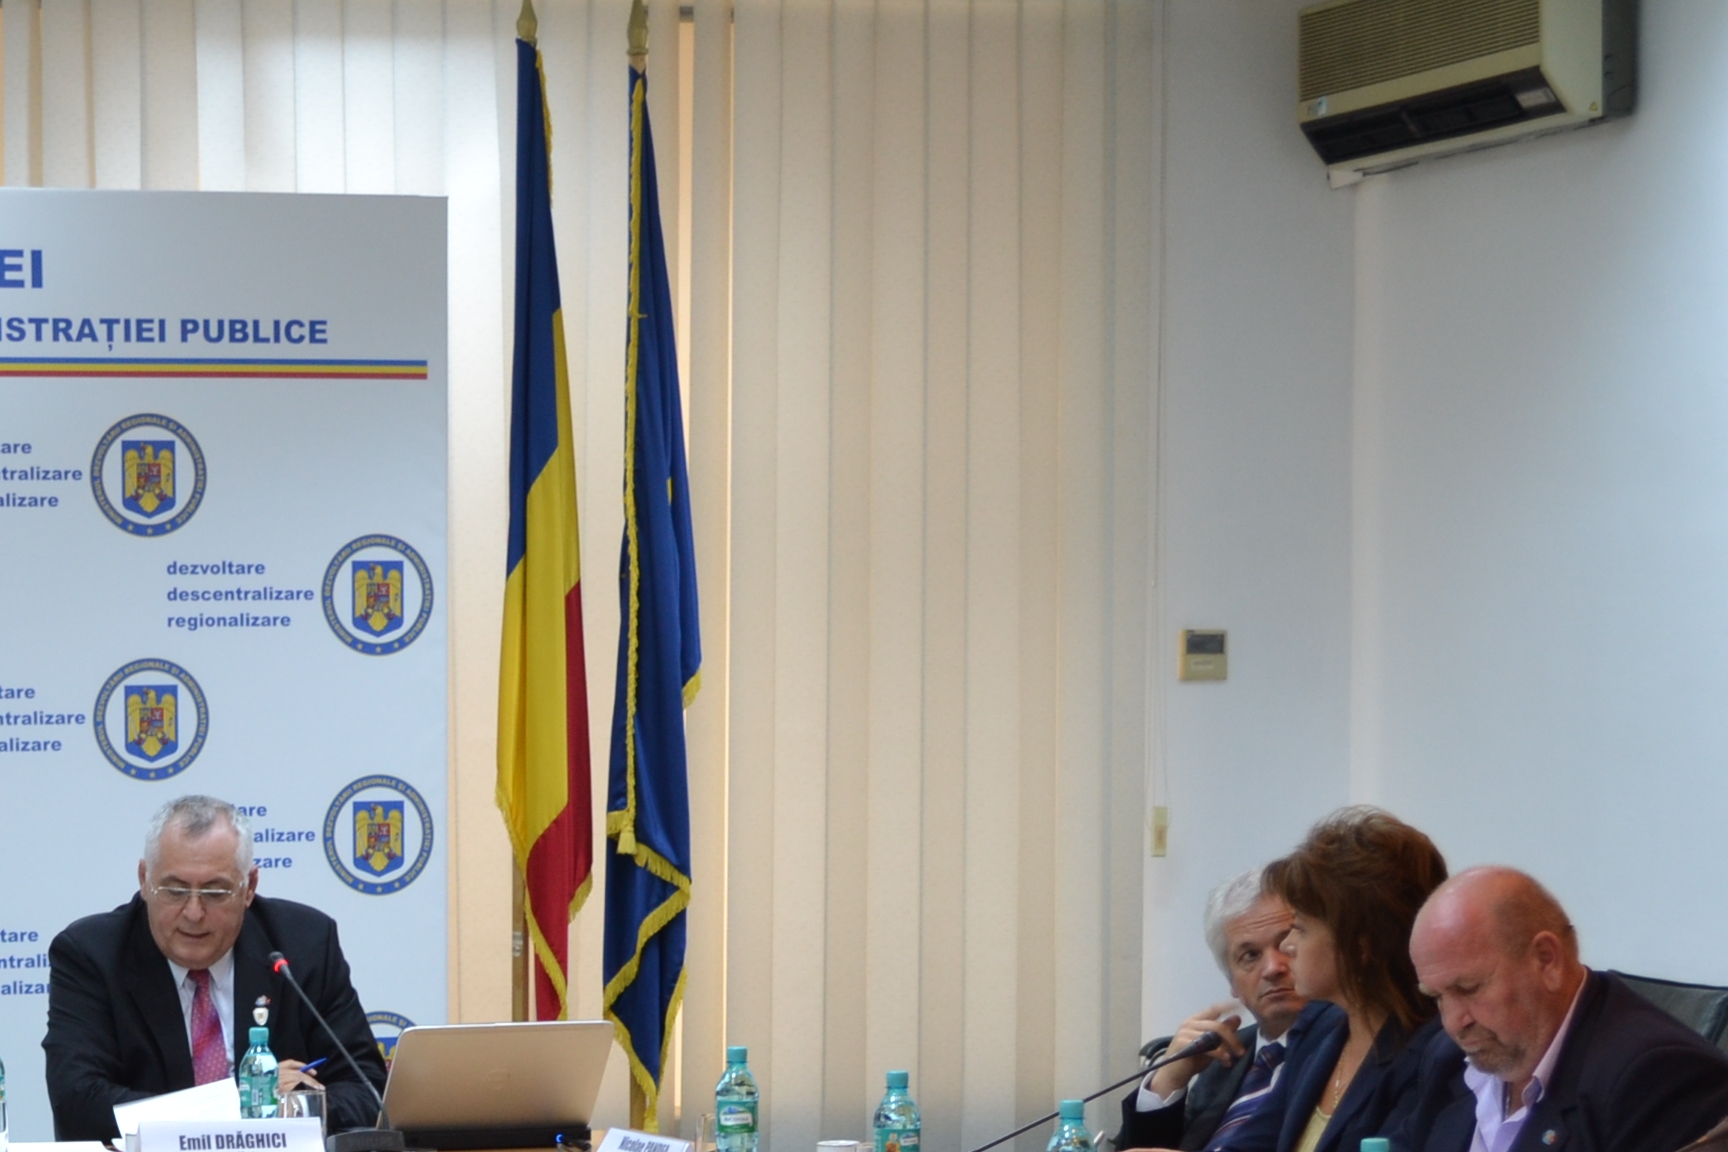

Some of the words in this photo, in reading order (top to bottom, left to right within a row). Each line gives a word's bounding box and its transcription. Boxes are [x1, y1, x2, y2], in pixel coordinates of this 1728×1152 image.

[180, 319, 328, 344] PUBLICE
[167, 561, 265, 575] dezvoltare
[167, 587, 314, 601] descentralizare
[168, 613, 291, 631] regionalizare
[179, 1134, 211, 1151] Emil
[215, 1130, 287, 1149] DRĂGHICI
